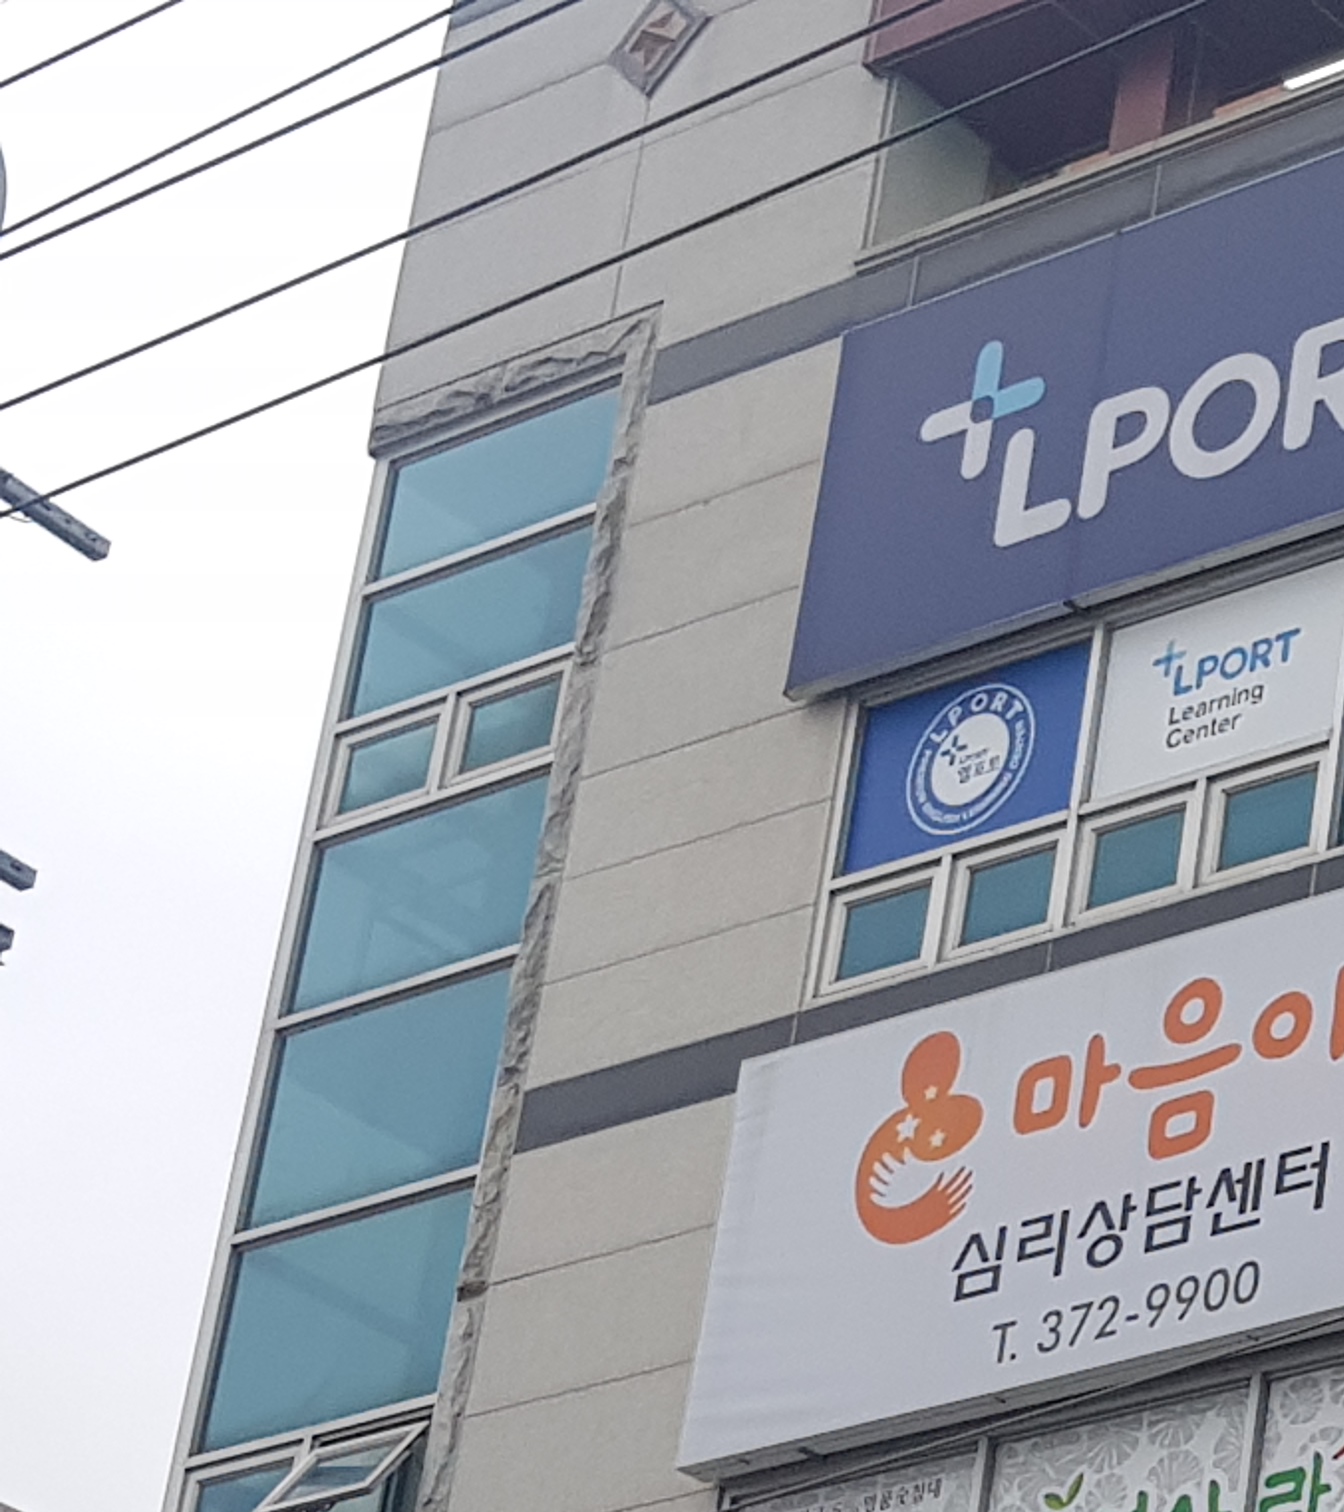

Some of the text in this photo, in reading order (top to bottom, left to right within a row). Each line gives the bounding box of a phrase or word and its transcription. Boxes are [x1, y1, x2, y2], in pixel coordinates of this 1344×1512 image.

[1172, 627, 1302, 698] LPORT
[929, 691, 1024, 745] LPORT
[1165, 711, 1243, 751] Center
[1167, 681, 1265, 726] Learning
[951, 1141, 1331, 1302] 심리상담센터
[992, 1261, 1261, 1364] T. 372-9900
